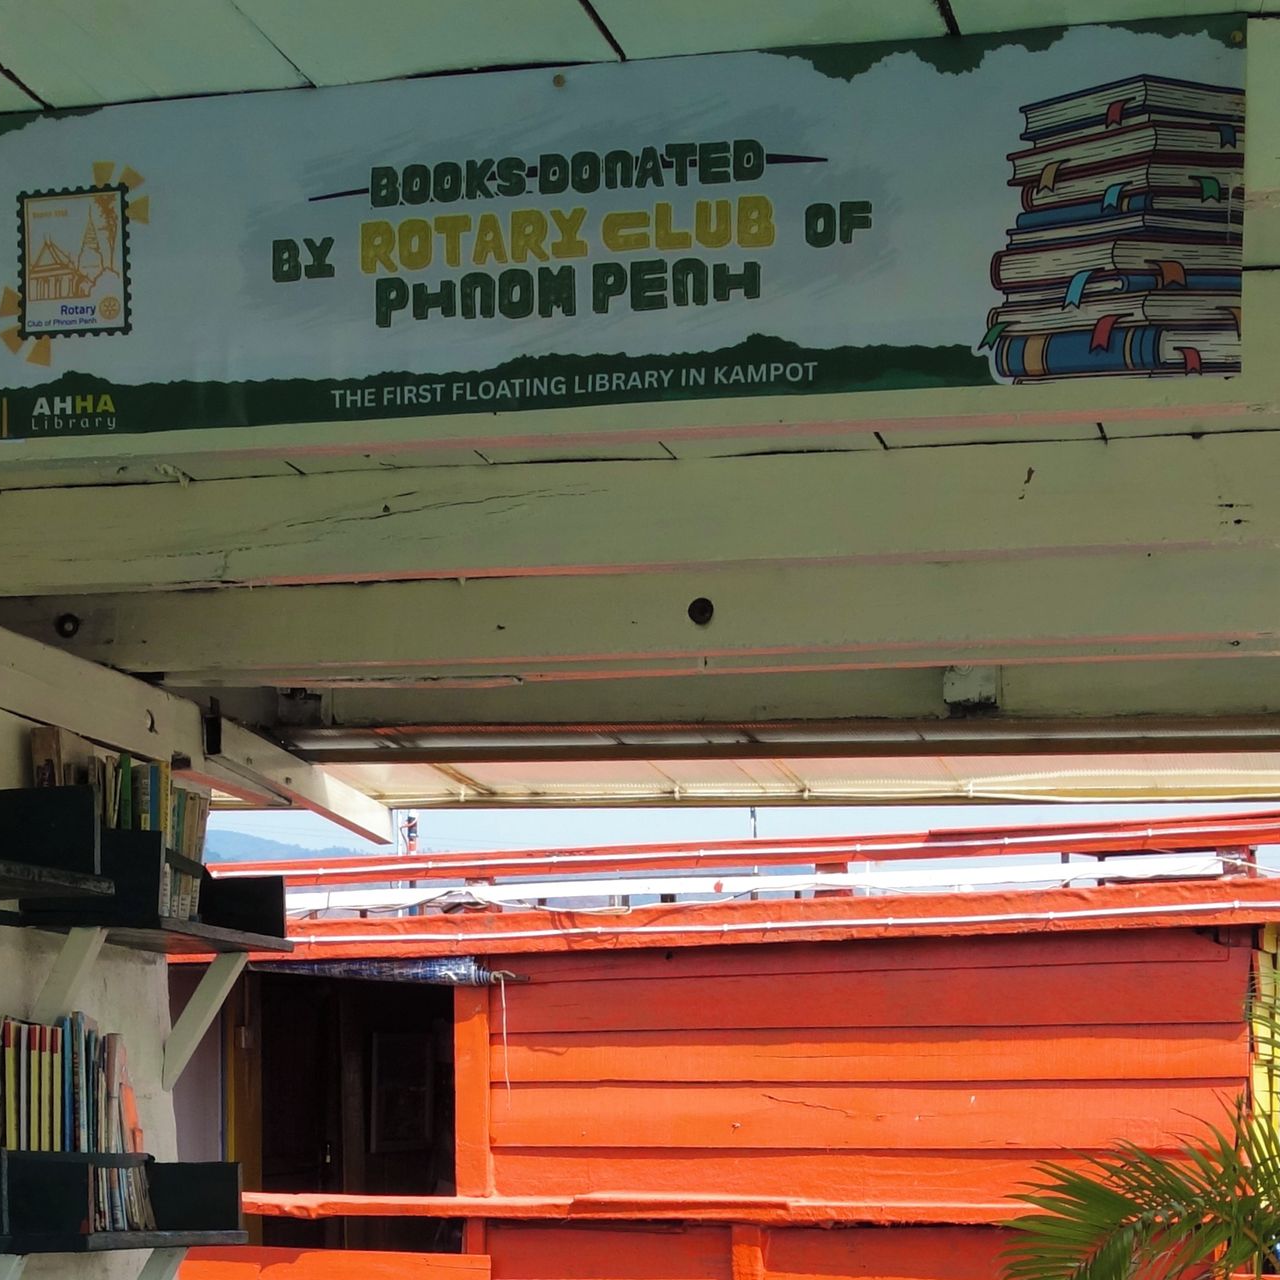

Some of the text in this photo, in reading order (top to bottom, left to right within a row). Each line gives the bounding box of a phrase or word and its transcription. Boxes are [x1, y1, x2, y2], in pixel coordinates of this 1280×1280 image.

[369, 139, 765, 208] BOOKS DONATED
[271, 195, 873, 283] BY ROTARY CLUB OF
[60, 304, 96, 317] Rotary
[375, 258, 761, 328] PHNOM PENH
[31, 394, 116, 416] AHHA
[331, 361, 819, 409] THE FIRST FLOATING LIBRARY IN KAMPOT
[31, 414, 116, 433] Library
